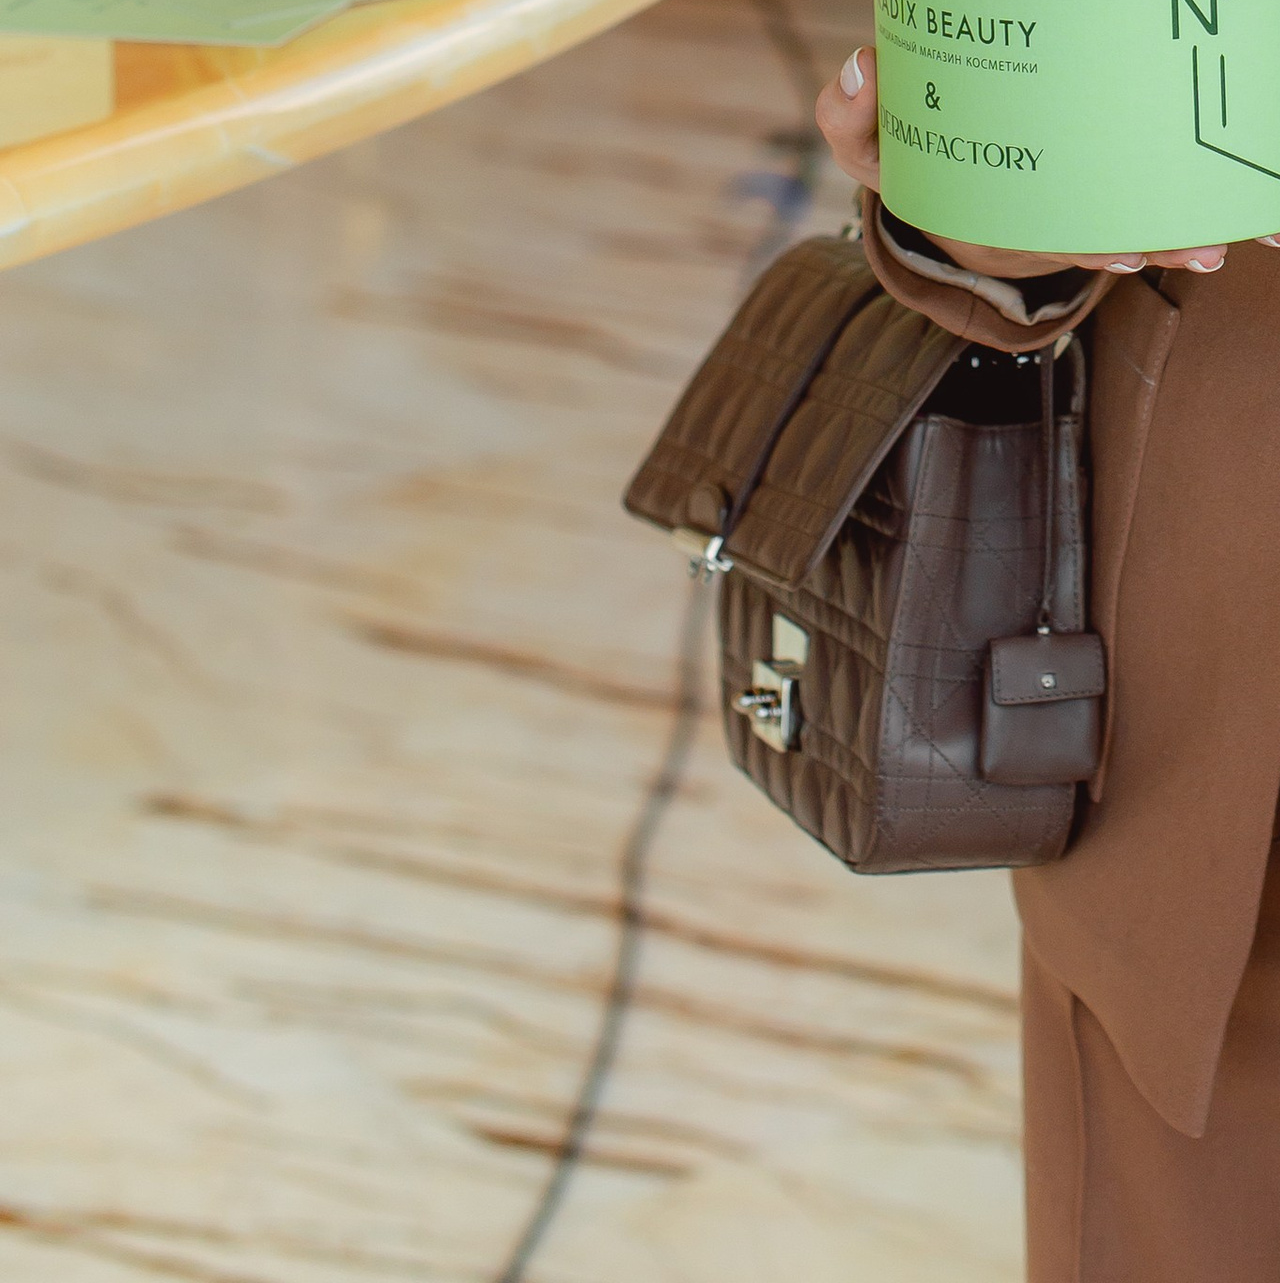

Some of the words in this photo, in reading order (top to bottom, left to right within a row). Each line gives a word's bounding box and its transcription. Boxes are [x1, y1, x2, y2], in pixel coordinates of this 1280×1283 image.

[927, 7, 1037, 48] BEAUTY
[919, 44, 962, 66] МАГАЗИН
[966, 55, 1038, 74] КОСМЕТИКИ
[925, 81, 942, 111] &
